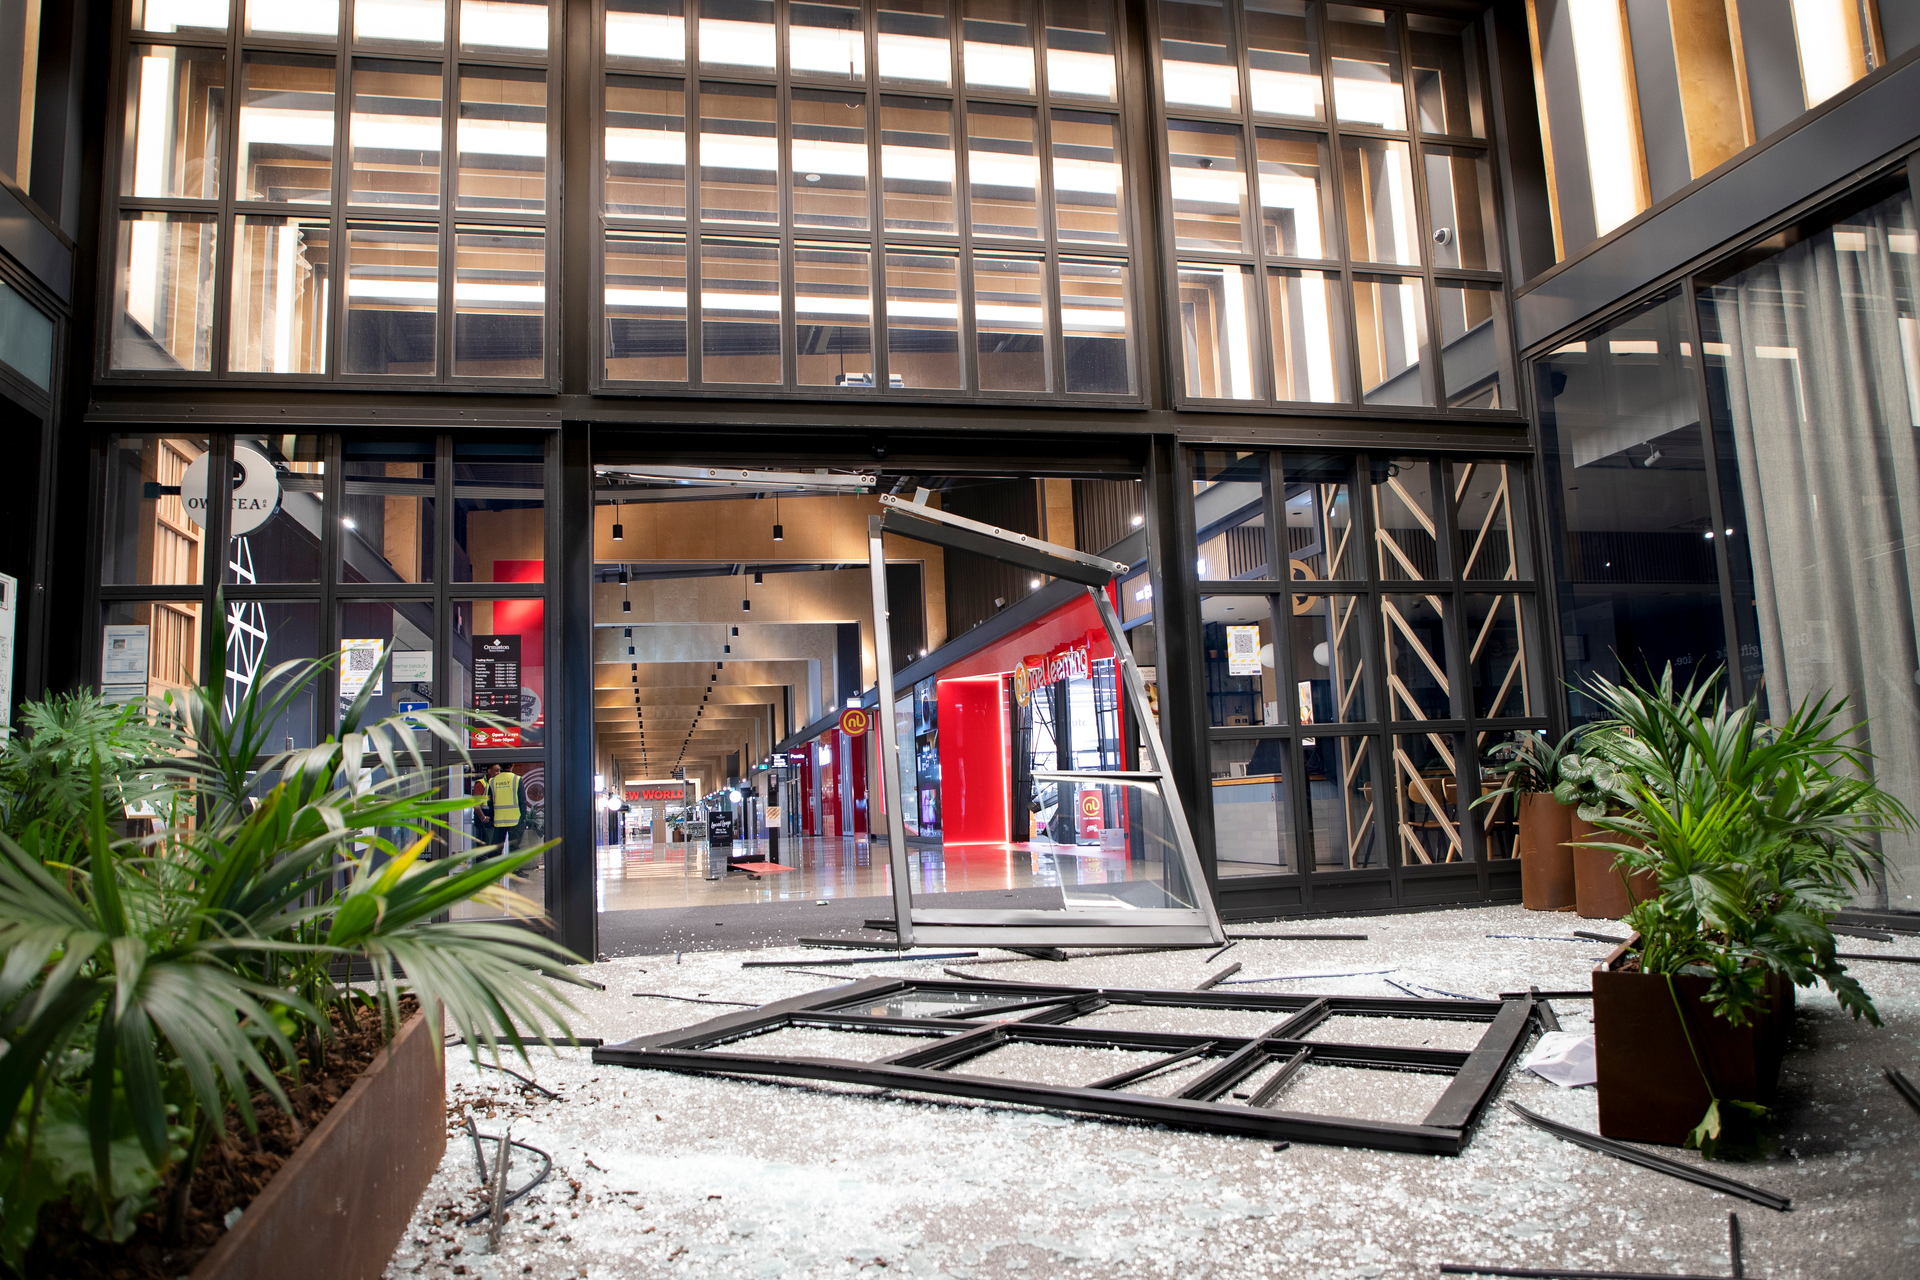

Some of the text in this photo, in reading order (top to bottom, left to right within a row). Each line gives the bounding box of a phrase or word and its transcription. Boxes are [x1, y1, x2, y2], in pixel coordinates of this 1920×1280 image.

[189, 498, 207, 509] OW
[1027, 646, 1088, 690] noel leeming
[625, 789, 684, 801] EW WORLD
